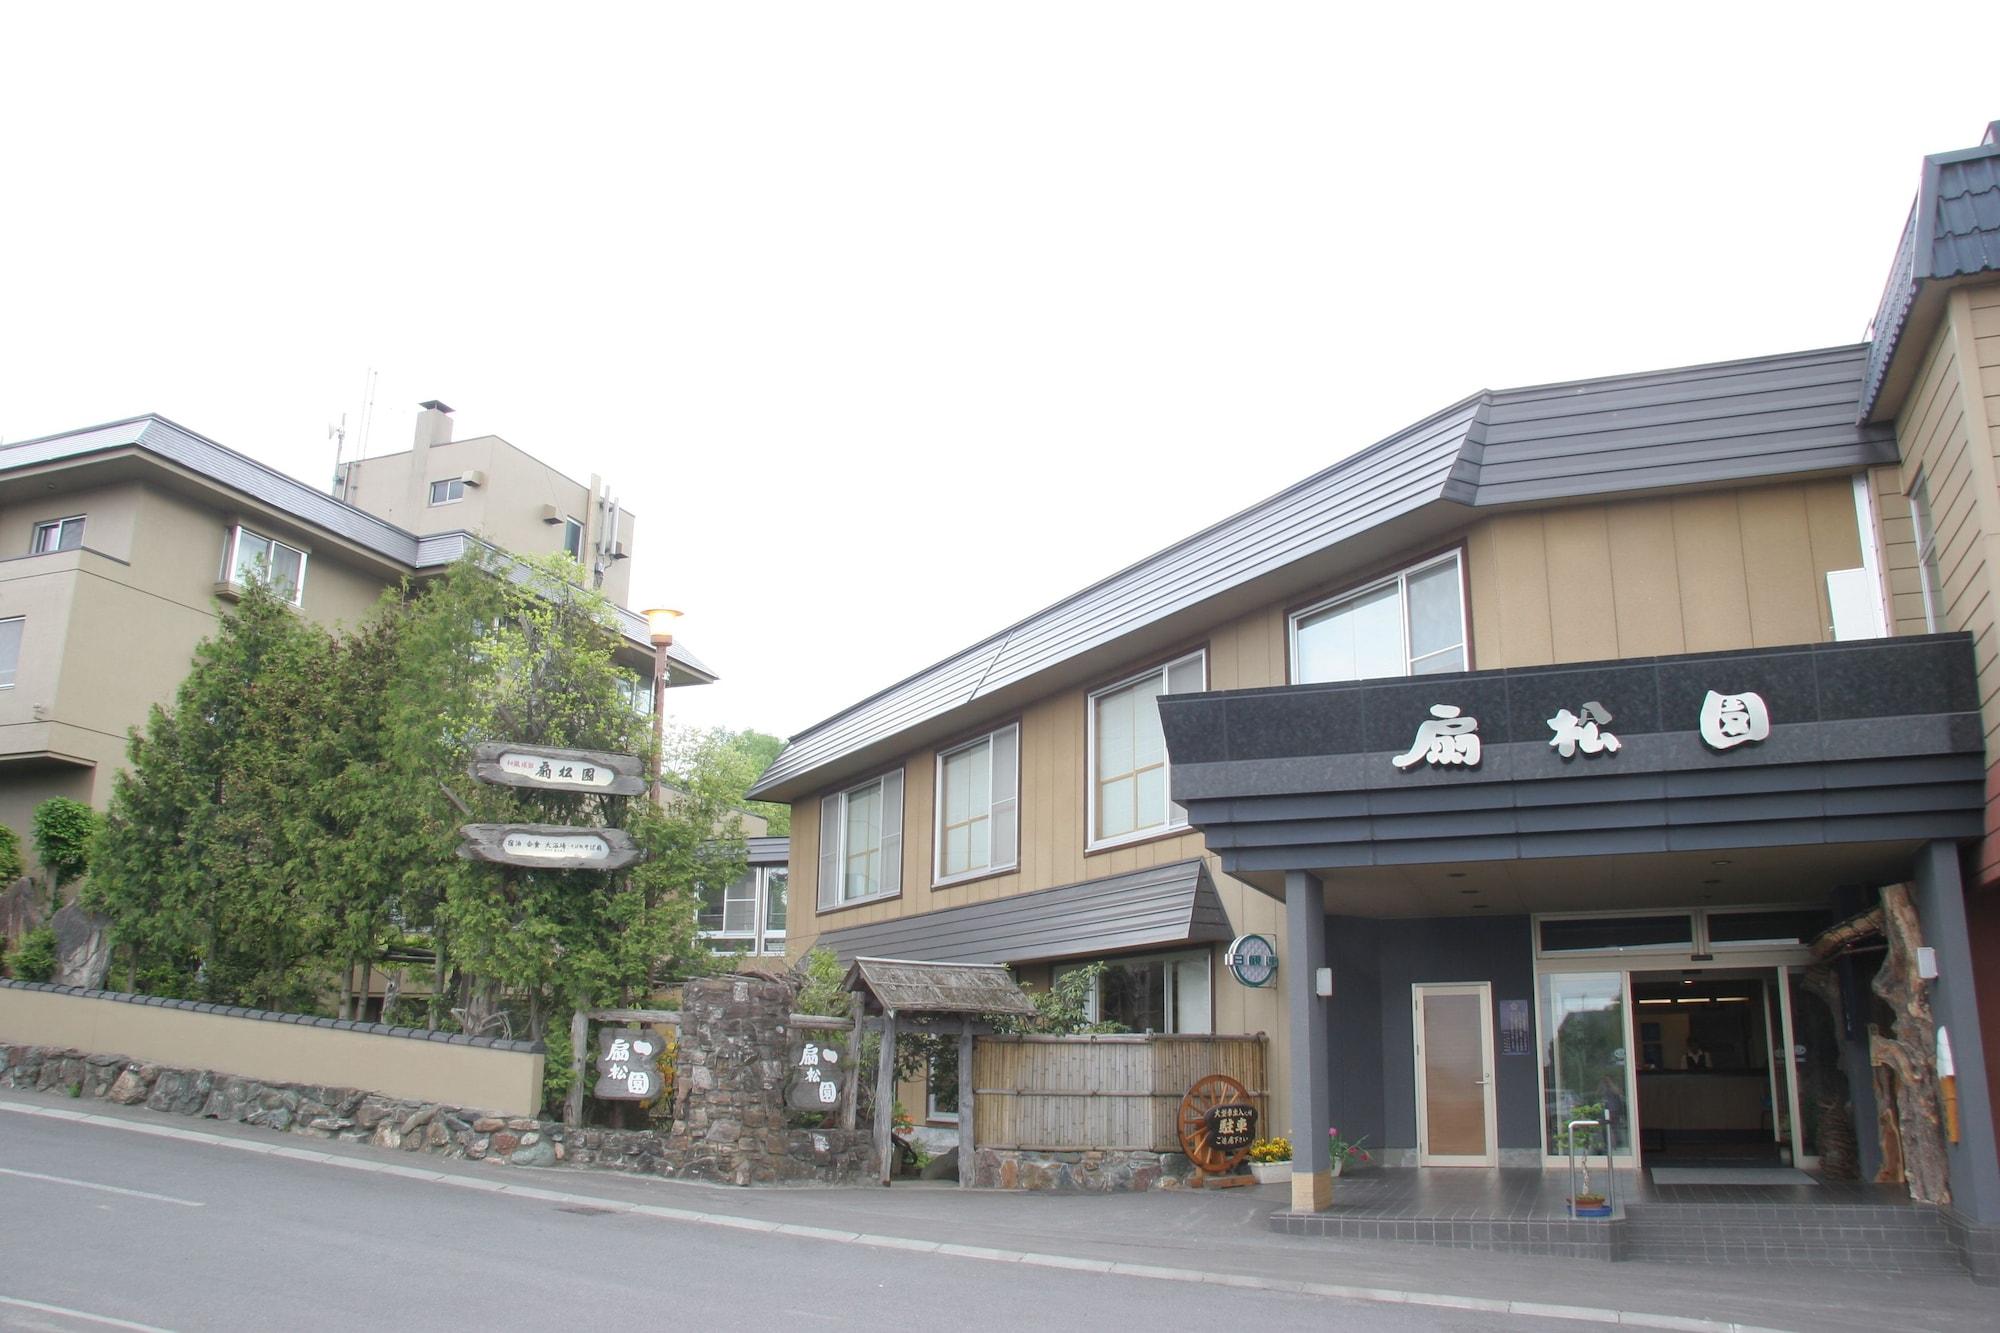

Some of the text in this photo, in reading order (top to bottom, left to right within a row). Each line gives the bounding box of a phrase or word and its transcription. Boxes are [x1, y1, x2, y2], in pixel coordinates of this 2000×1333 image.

[1391, 689, 1771, 770] 扇松園
[536, 761, 595, 781] 扇松園
[605, 1038, 650, 1095] 扇松園
[799, 1043, 837, 1103] 扇松園
[1218, 1117, 1248, 1134] 駐車
